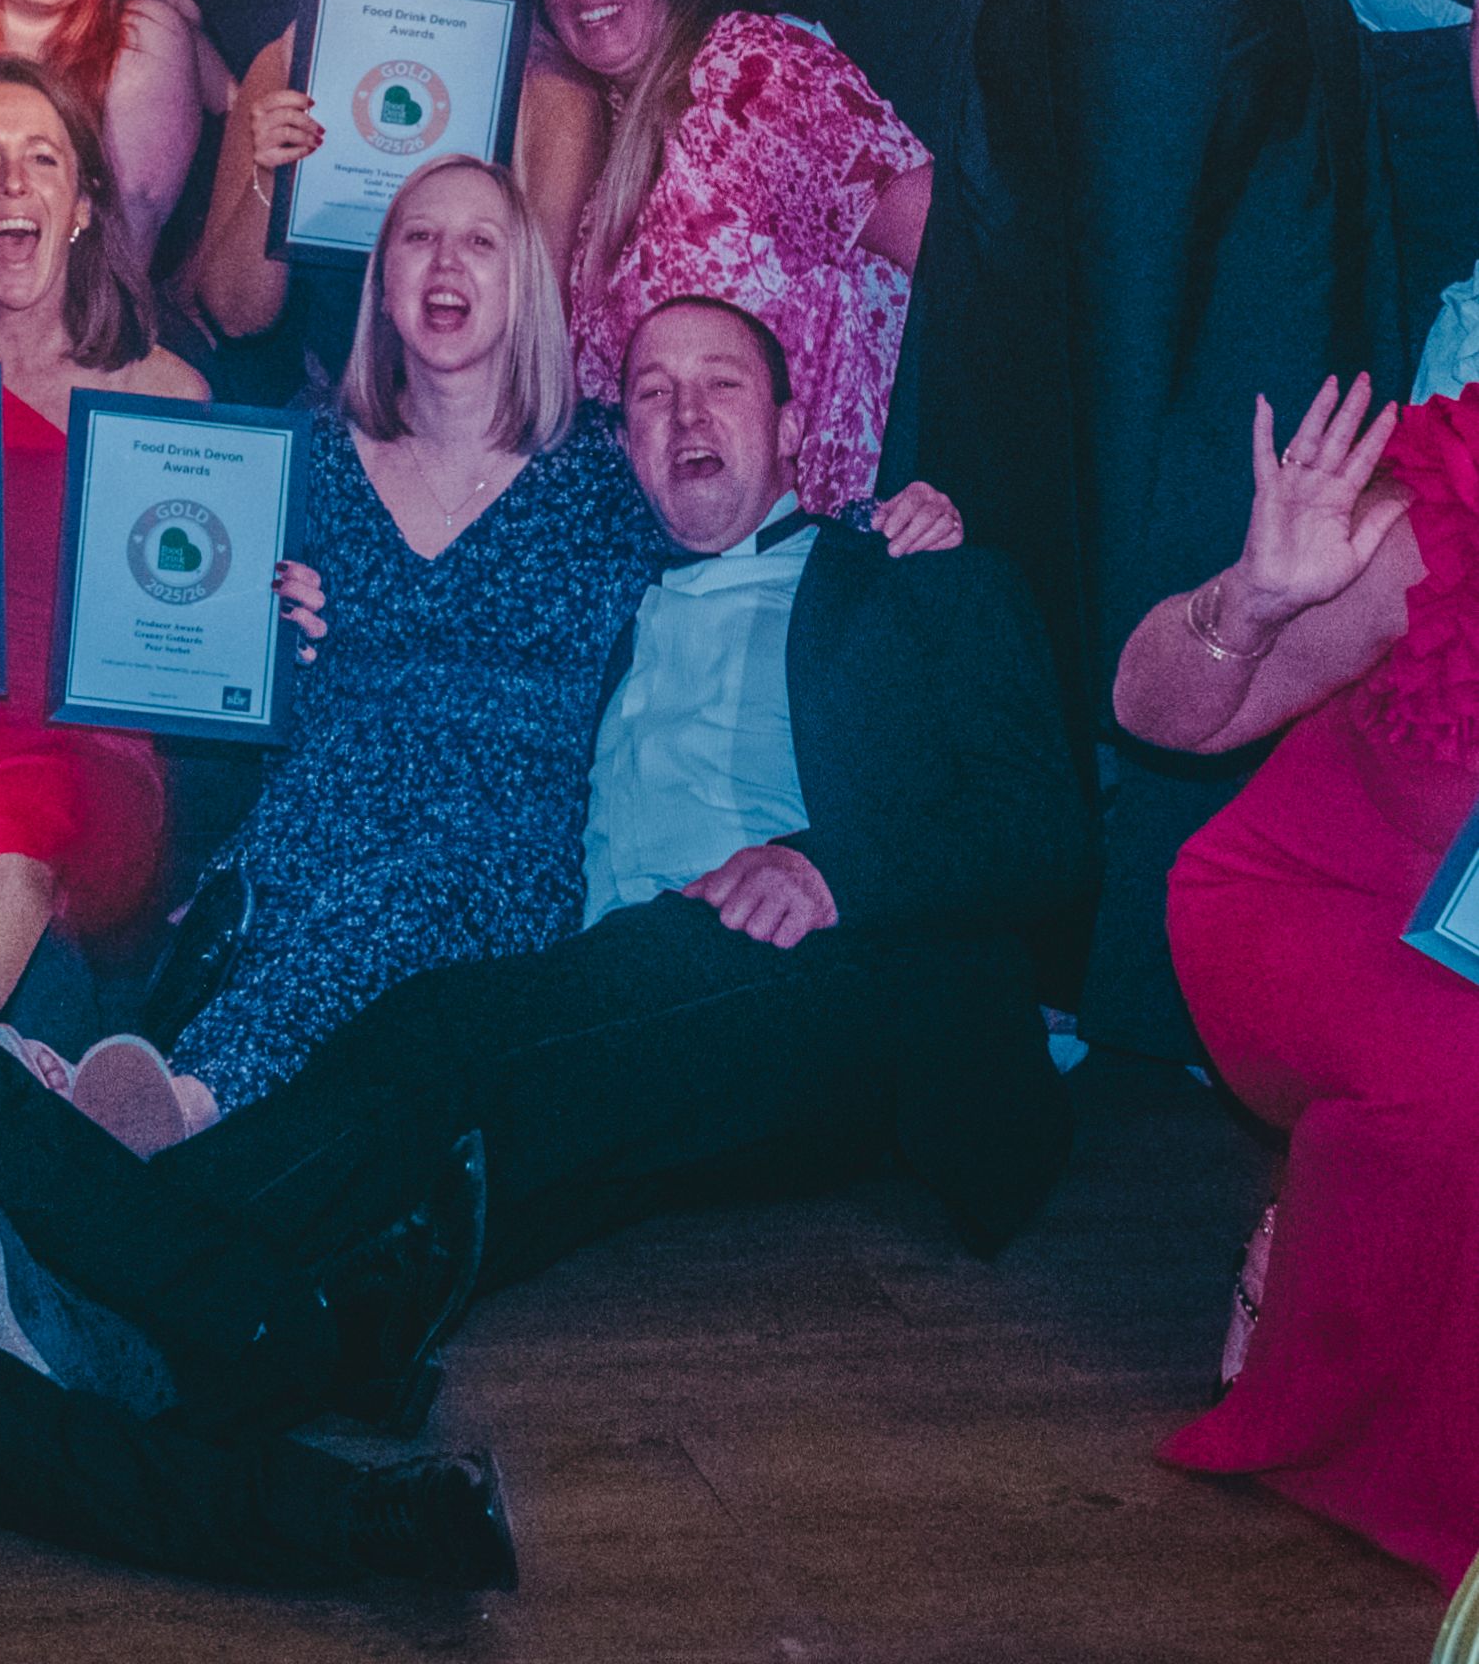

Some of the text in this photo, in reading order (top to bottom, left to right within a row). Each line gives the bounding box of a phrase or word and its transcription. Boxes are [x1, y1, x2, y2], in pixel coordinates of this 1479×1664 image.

[361, 4, 467, 28] Food Drink Devon
[388, 24, 435, 40] Awards
[381, 63, 431, 82] GOLD
[368, 132, 425, 153] 2025/26
[132, 439, 243, 463] Food Drink Devon
[162, 460, 210, 476] Awards
[156, 503, 209, 523] GOLD
[146, 580, 207, 603] 2025/26
